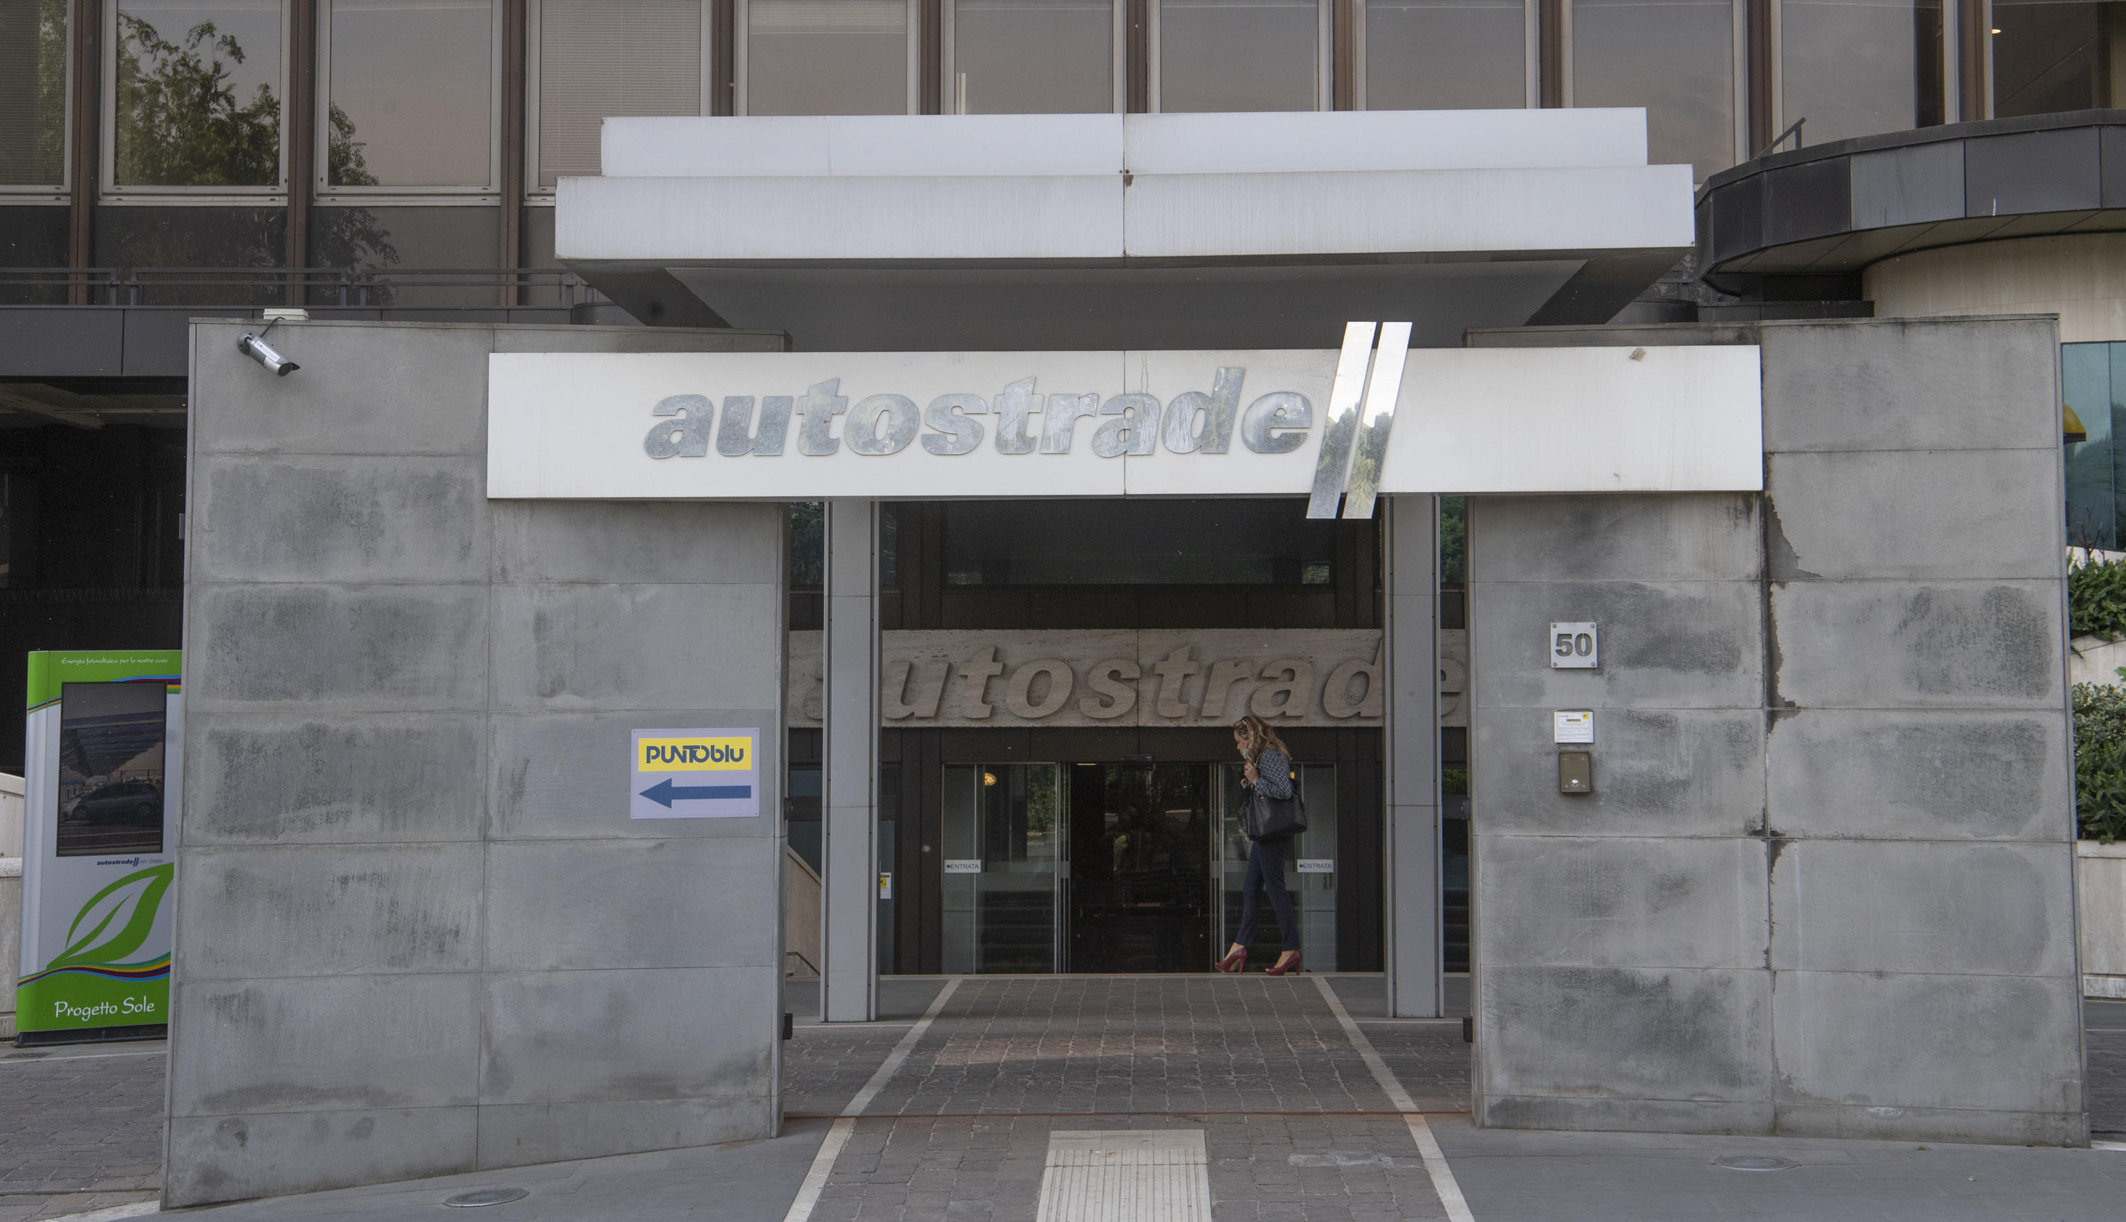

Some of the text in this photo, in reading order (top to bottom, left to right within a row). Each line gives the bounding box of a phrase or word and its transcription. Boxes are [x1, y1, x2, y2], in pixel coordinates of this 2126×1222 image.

[643, 366, 1312, 459] autostrade
[1554, 633, 1593, 657] 50
[646, 744, 744, 764] PUNTOblu
[54, 995, 155, 1022] Progetto Sole
